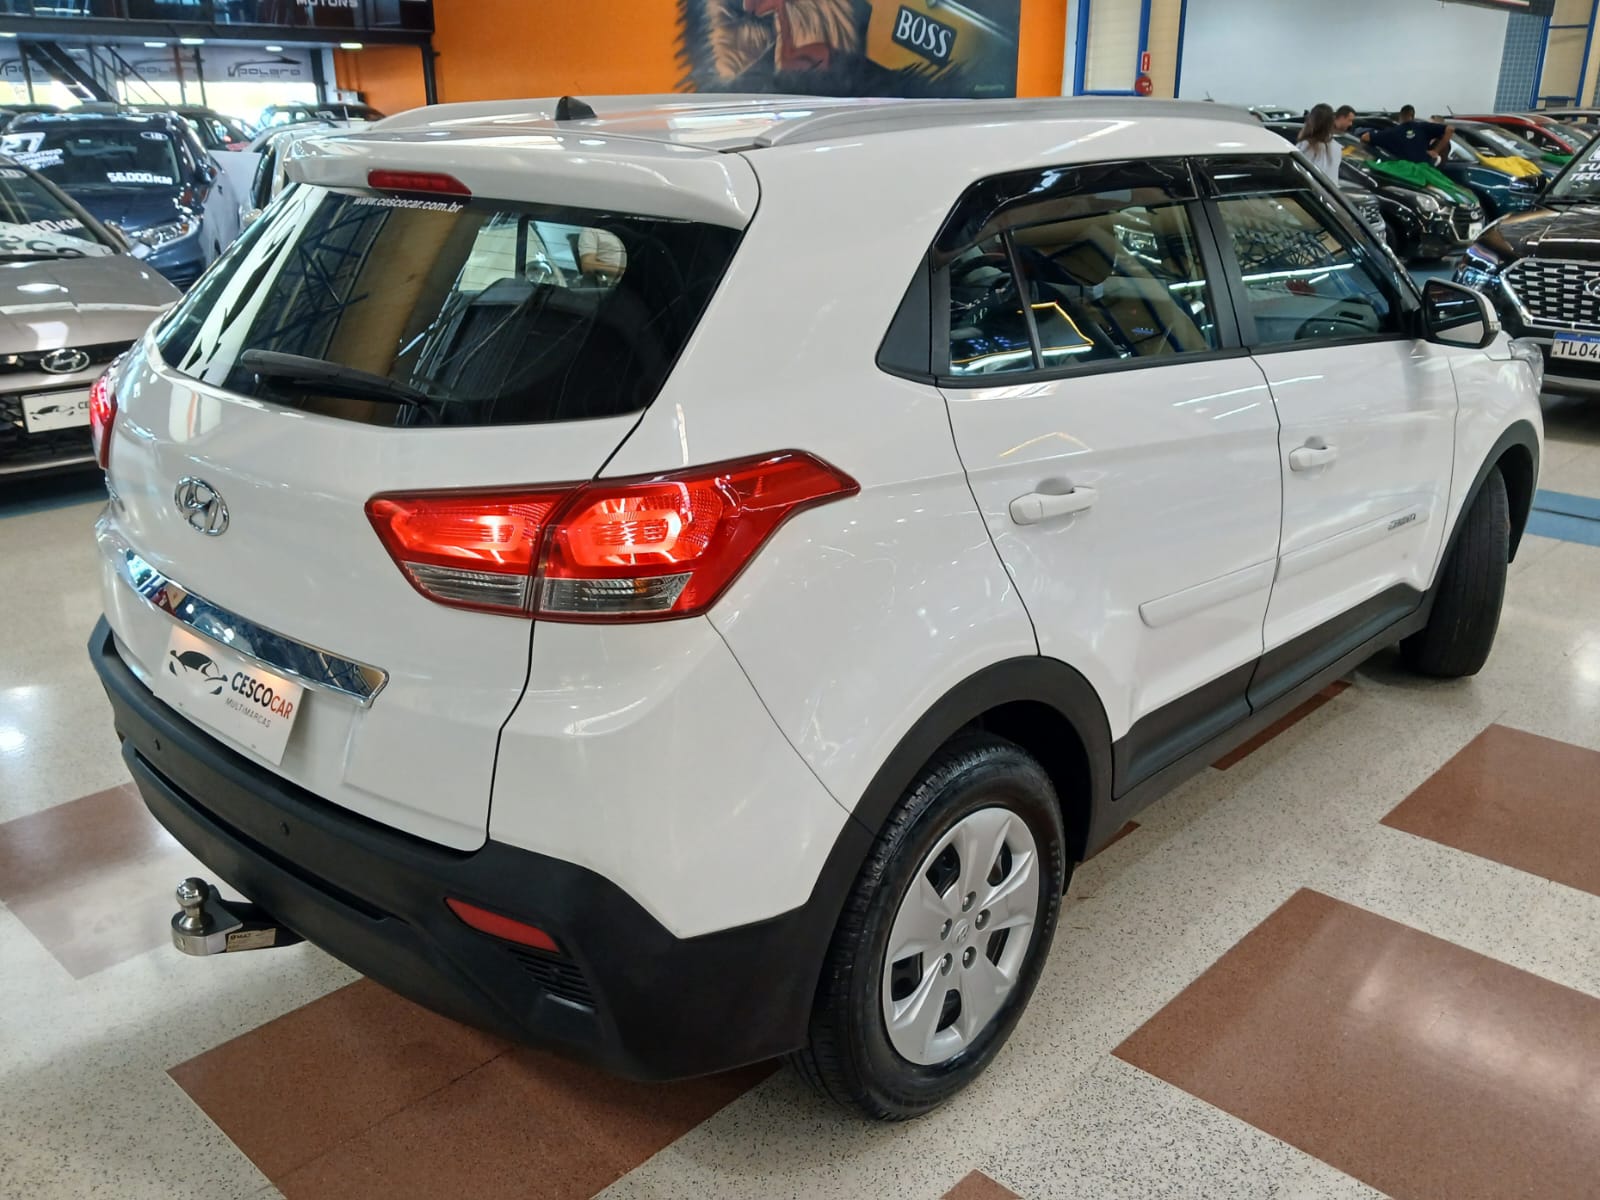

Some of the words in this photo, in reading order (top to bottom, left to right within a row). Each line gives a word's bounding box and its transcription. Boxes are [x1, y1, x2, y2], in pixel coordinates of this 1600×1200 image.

[896, 9, 951, 58] BOSS
[353, 197, 464, 213] www.cescocar.com.br
[1561, 341, 1600, 358] TL04
[231, 671, 294, 719] CESCOCAR
[226, 697, 272, 728] MULTIMARCAS
